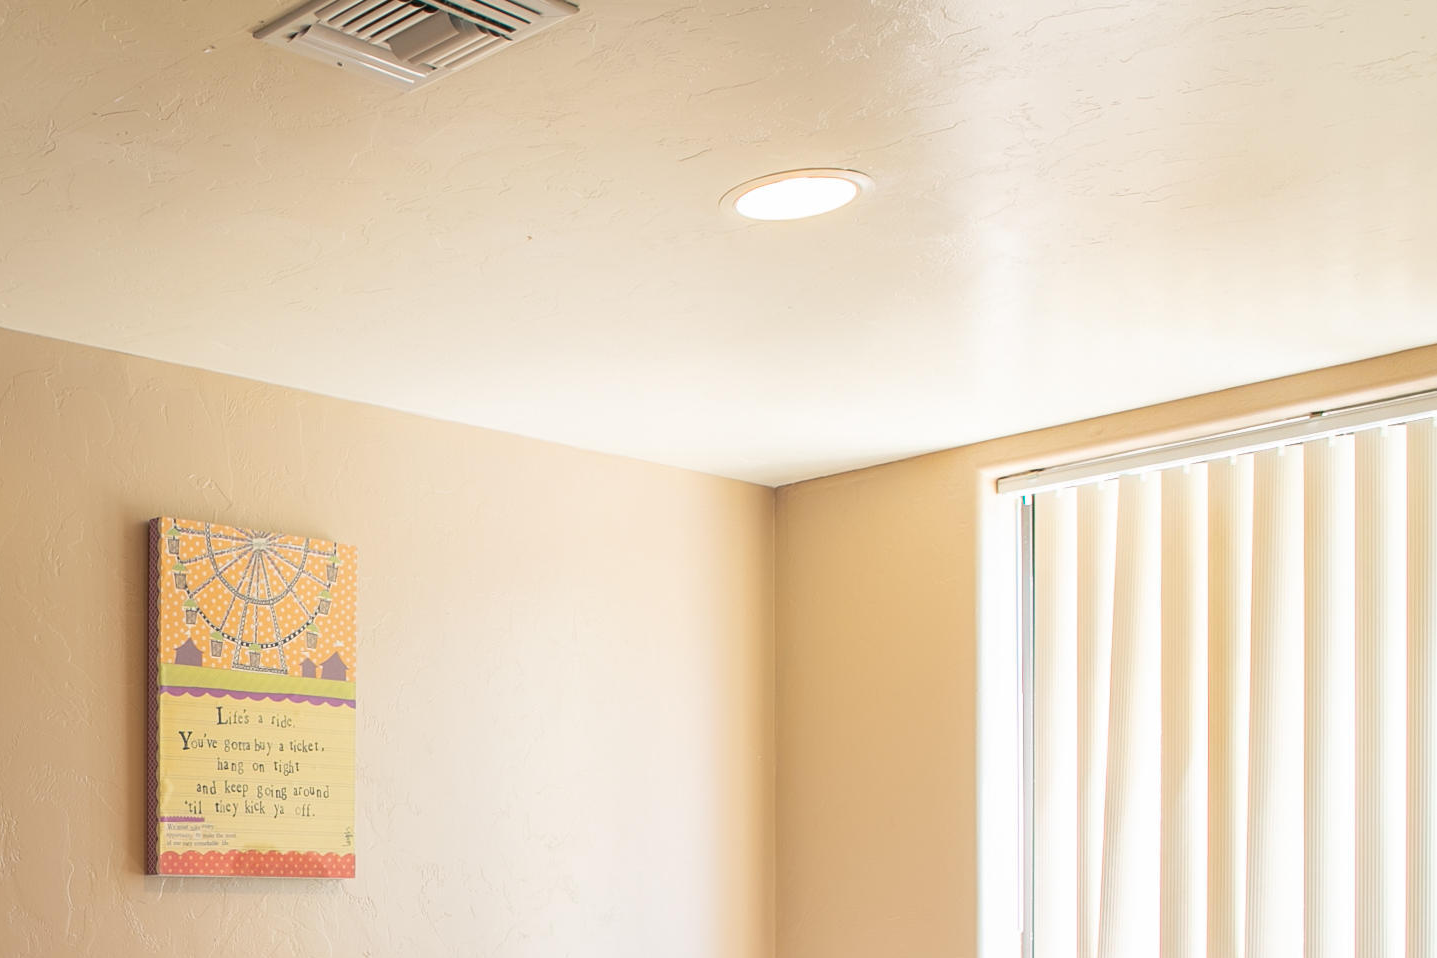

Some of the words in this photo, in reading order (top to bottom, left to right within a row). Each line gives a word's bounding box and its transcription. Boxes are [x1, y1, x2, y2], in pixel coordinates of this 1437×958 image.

[217, 706, 249, 726] Life's
[258, 713, 263, 723] a
[179, 731, 218, 750] You've
[224, 739, 250, 752] gotta
[254, 739, 272, 756] buy
[279, 743, 284, 751] a
[217, 758, 244, 775] hang
[253, 762, 264, 772] on
[274, 761, 300, 776] tight
[196, 781, 216, 795] and
[225, 780, 248, 796] keep
[257, 784, 287, 800] going
[293, 785, 330, 798] around
[215, 802, 239, 817] they
[245, 801, 265, 814] kick
[274, 805, 285, 818] ya
[295, 804, 316, 817] off.
